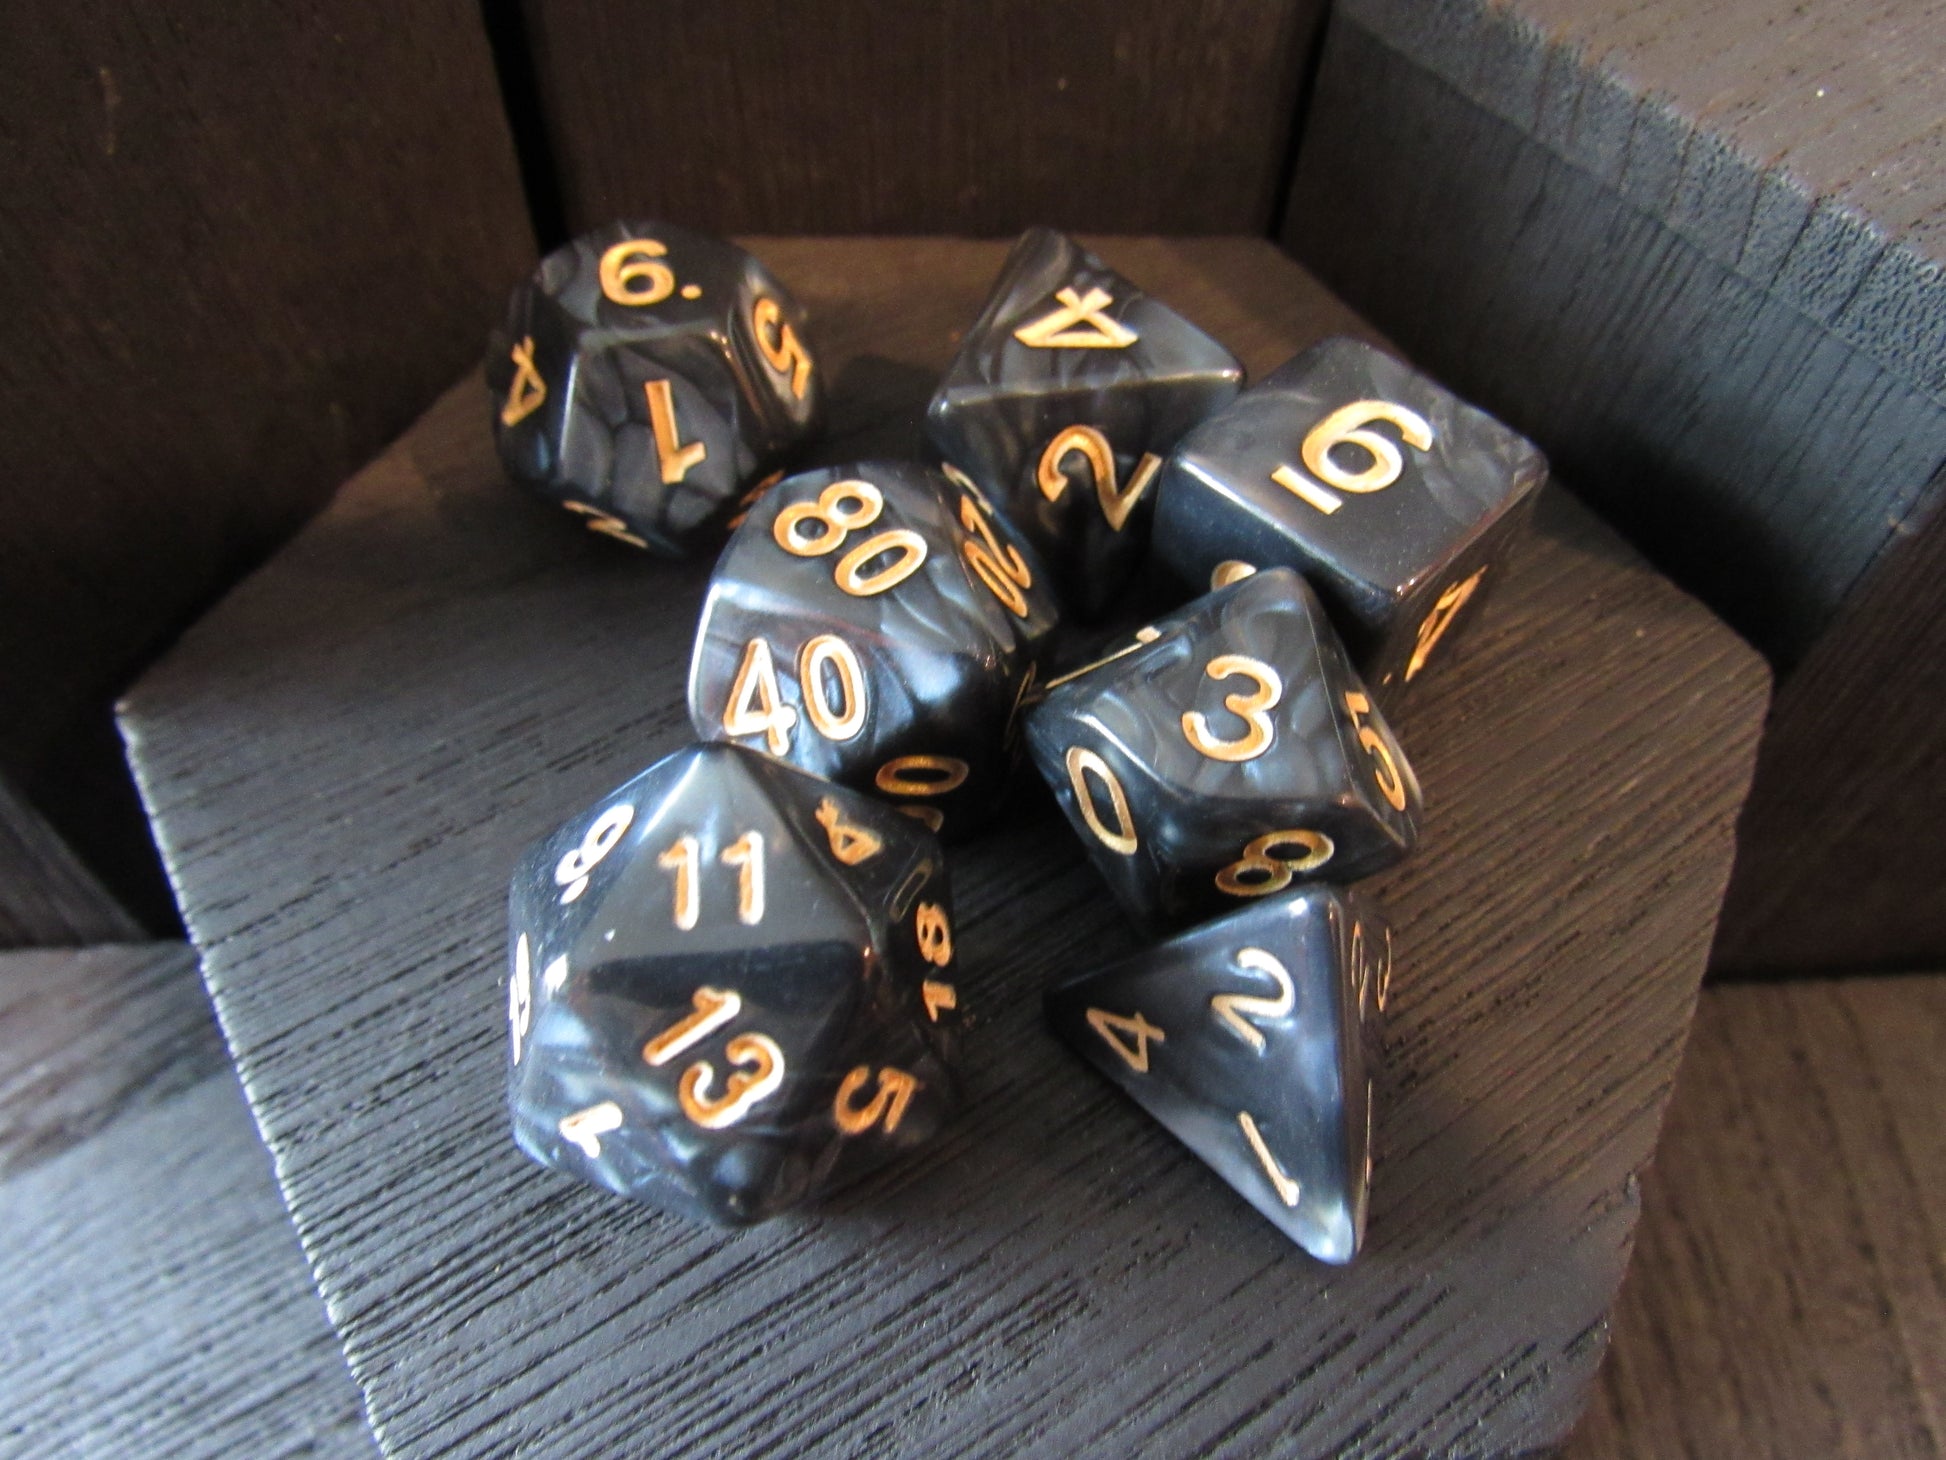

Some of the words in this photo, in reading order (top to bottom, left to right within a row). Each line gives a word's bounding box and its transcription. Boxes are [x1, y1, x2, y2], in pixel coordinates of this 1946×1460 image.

[754, 298, 814, 401] 5
[1014, 286, 1139, 349] 4
[501, 336, 547, 427] 4
[644, 379, 707, 485] 1
[1038, 424, 1163, 532] 2
[773, 480, 928, 596] 80
[960, 494, 1032, 618] 20
[723, 634, 867, 756] 40
[1182, 654, 1283, 762] 3
[1066, 746, 1138, 856] 0
[1344, 691, 1406, 812] 5
[658, 829, 765, 931] 11
[814, 796, 884, 866] 4
[1215, 829, 1335, 897] 8
[1086, 1007, 1166, 1073] 4
[1211, 946, 1295, 1054] 2
[642, 985, 785, 1131] 13
[834, 1064, 917, 1135] 5
[1238, 1110, 1300, 1207] 1
